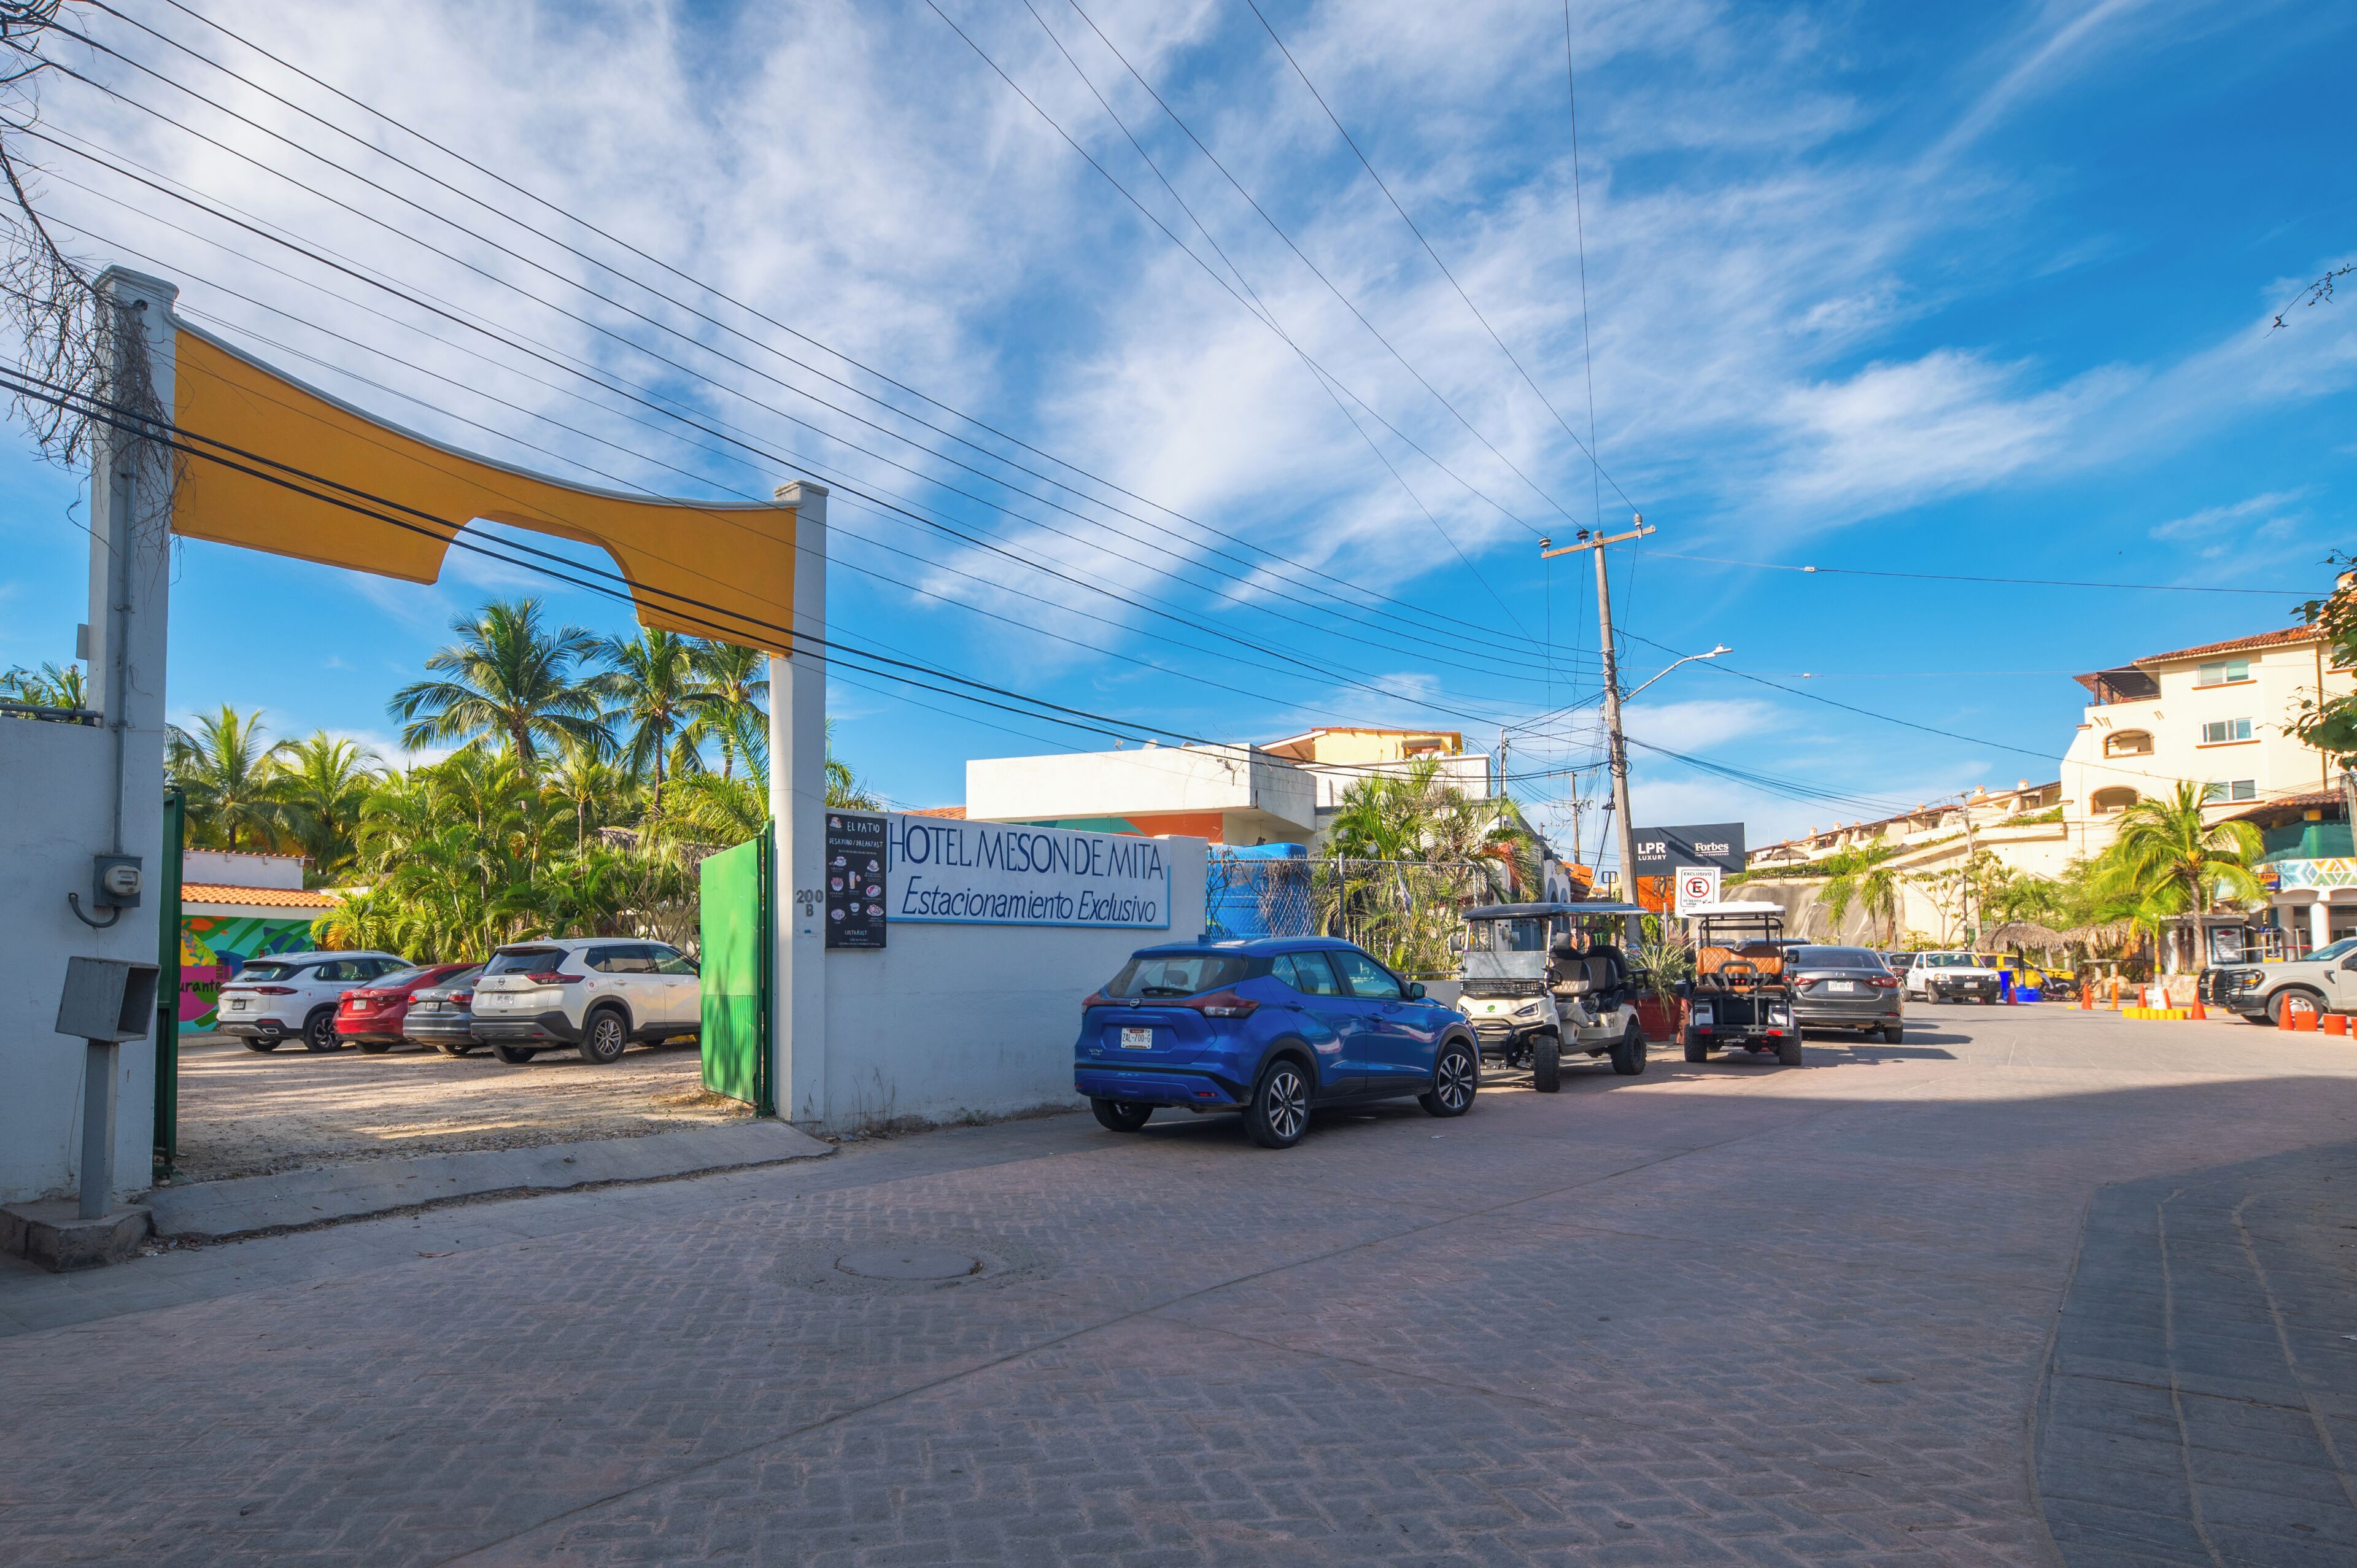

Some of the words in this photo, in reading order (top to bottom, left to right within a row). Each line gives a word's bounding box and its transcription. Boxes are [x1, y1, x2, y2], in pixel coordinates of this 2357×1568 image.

[847, 822, 855, 832] EL
[857, 822, 880, 833] PATIO
[888, 814, 972, 873] HOTEL
[976, 830, 1069, 875] MESON
[1075, 837, 1104, 876] DE
[1107, 841, 1163, 880] MITA
[1638, 842, 1666, 854] LPR
[1695, 842, 1729, 851] Forbes
[796, 889, 824, 903] 200
[902, 876, 1073, 919] Estacionamiento
[1077, 890, 1156, 922] Exclusivo
[806, 903, 814, 917] B
[1122, 1033, 1151, 1043] ZAL-700-G
